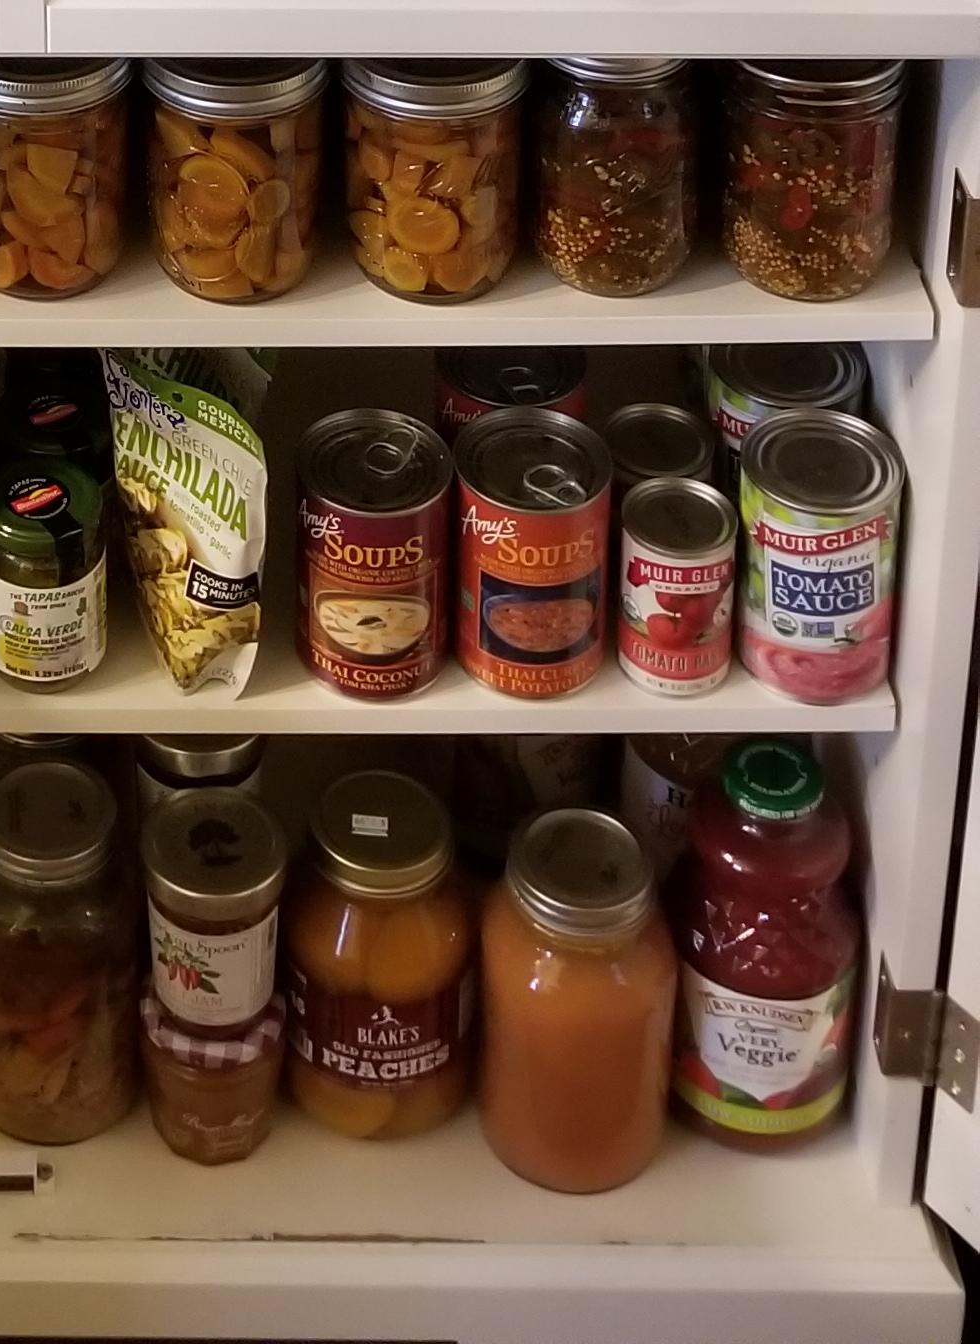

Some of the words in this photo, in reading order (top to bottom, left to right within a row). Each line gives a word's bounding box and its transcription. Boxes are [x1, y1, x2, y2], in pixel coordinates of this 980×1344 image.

[171, 429, 220, 468] GREEN
[116, 413, 248, 542] ENCHILADA
[299, 498, 342, 538] Amy's
[461, 505, 517, 545] Amy's
[324, 532, 424, 568] SOUPS
[498, 530, 595, 567] SOUPS
[765, 527, 817, 552] MUIR
[822, 521, 878, 550] GLEN
[194, 570, 229, 592] COOKS
[230, 581, 244, 593] IN
[640, 563, 683, 584] MUIR
[692, 562, 730, 582] GLEN
[772, 566, 873, 596] TOMATO
[24, 592, 61, 602] TAPAS
[191, 580, 208, 601] 15
[773, 587, 873, 613] SAUCE
[5, 621, 41, 637] SALSA
[47, 618, 84, 637] VERDE
[312, 648, 348, 679] THAI
[632, 640, 688, 673] TOMATO
[357, 1026, 420, 1045] BLAKE'S
[717, 1032, 797, 1067] Veggie
[739, 1033, 777, 1048] VERY
[322, 1043, 450, 1081] PEACHES
